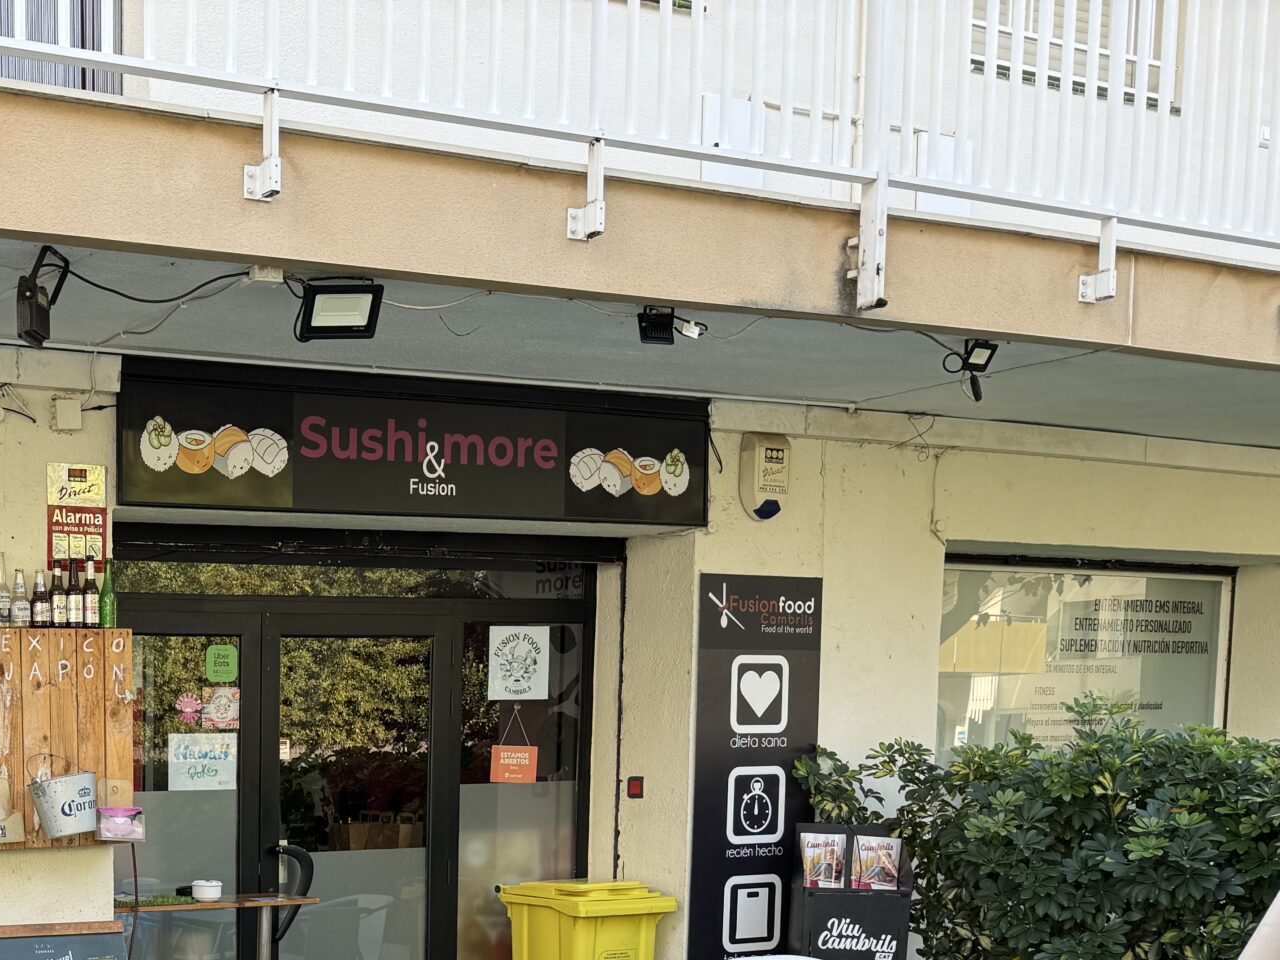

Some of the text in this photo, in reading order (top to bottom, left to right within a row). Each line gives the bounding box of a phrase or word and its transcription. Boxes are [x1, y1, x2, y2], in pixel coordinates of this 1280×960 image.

[300, 416, 559, 478] Sushi & more
[58, 483, 99, 500] Direct
[410, 478, 457, 496] Fusion
[52, 508, 103, 525] Alarma
[1094, 599, 1204, 614] ENTRENAMIENTO EMS INTEGRAL
[761, 613, 814, 625] Cambrils
[1074, 617, 1192, 633] ENTRENAMIENTO PERSONALIZADO
[777, 625, 783, 633] of
[784, 625, 794, 634] the
[795, 625, 812, 634] world
[494, 632, 542, 658] FUSION FOOD
[1126, 640, 1132, 653] Y
[1132, 637, 1170, 653] NUTRICIÓN
[1172, 640, 1208, 655] DEPORTIVA
[213, 652, 230, 660] Uber
[1053, 664, 1074, 673] MINUTOS
[1076, 664, 1083, 673] DE
[1083, 664, 1094, 674] EMS
[1095, 664, 1117, 674] INTEGRAL
[1034, 686, 1056, 696] FITNESS
[730, 734, 787, 748] dieta sana
[726, 844, 784, 858] recién hecho
[827, 918, 862, 936] Viu
[818, 930, 897, 952] Cambrils
